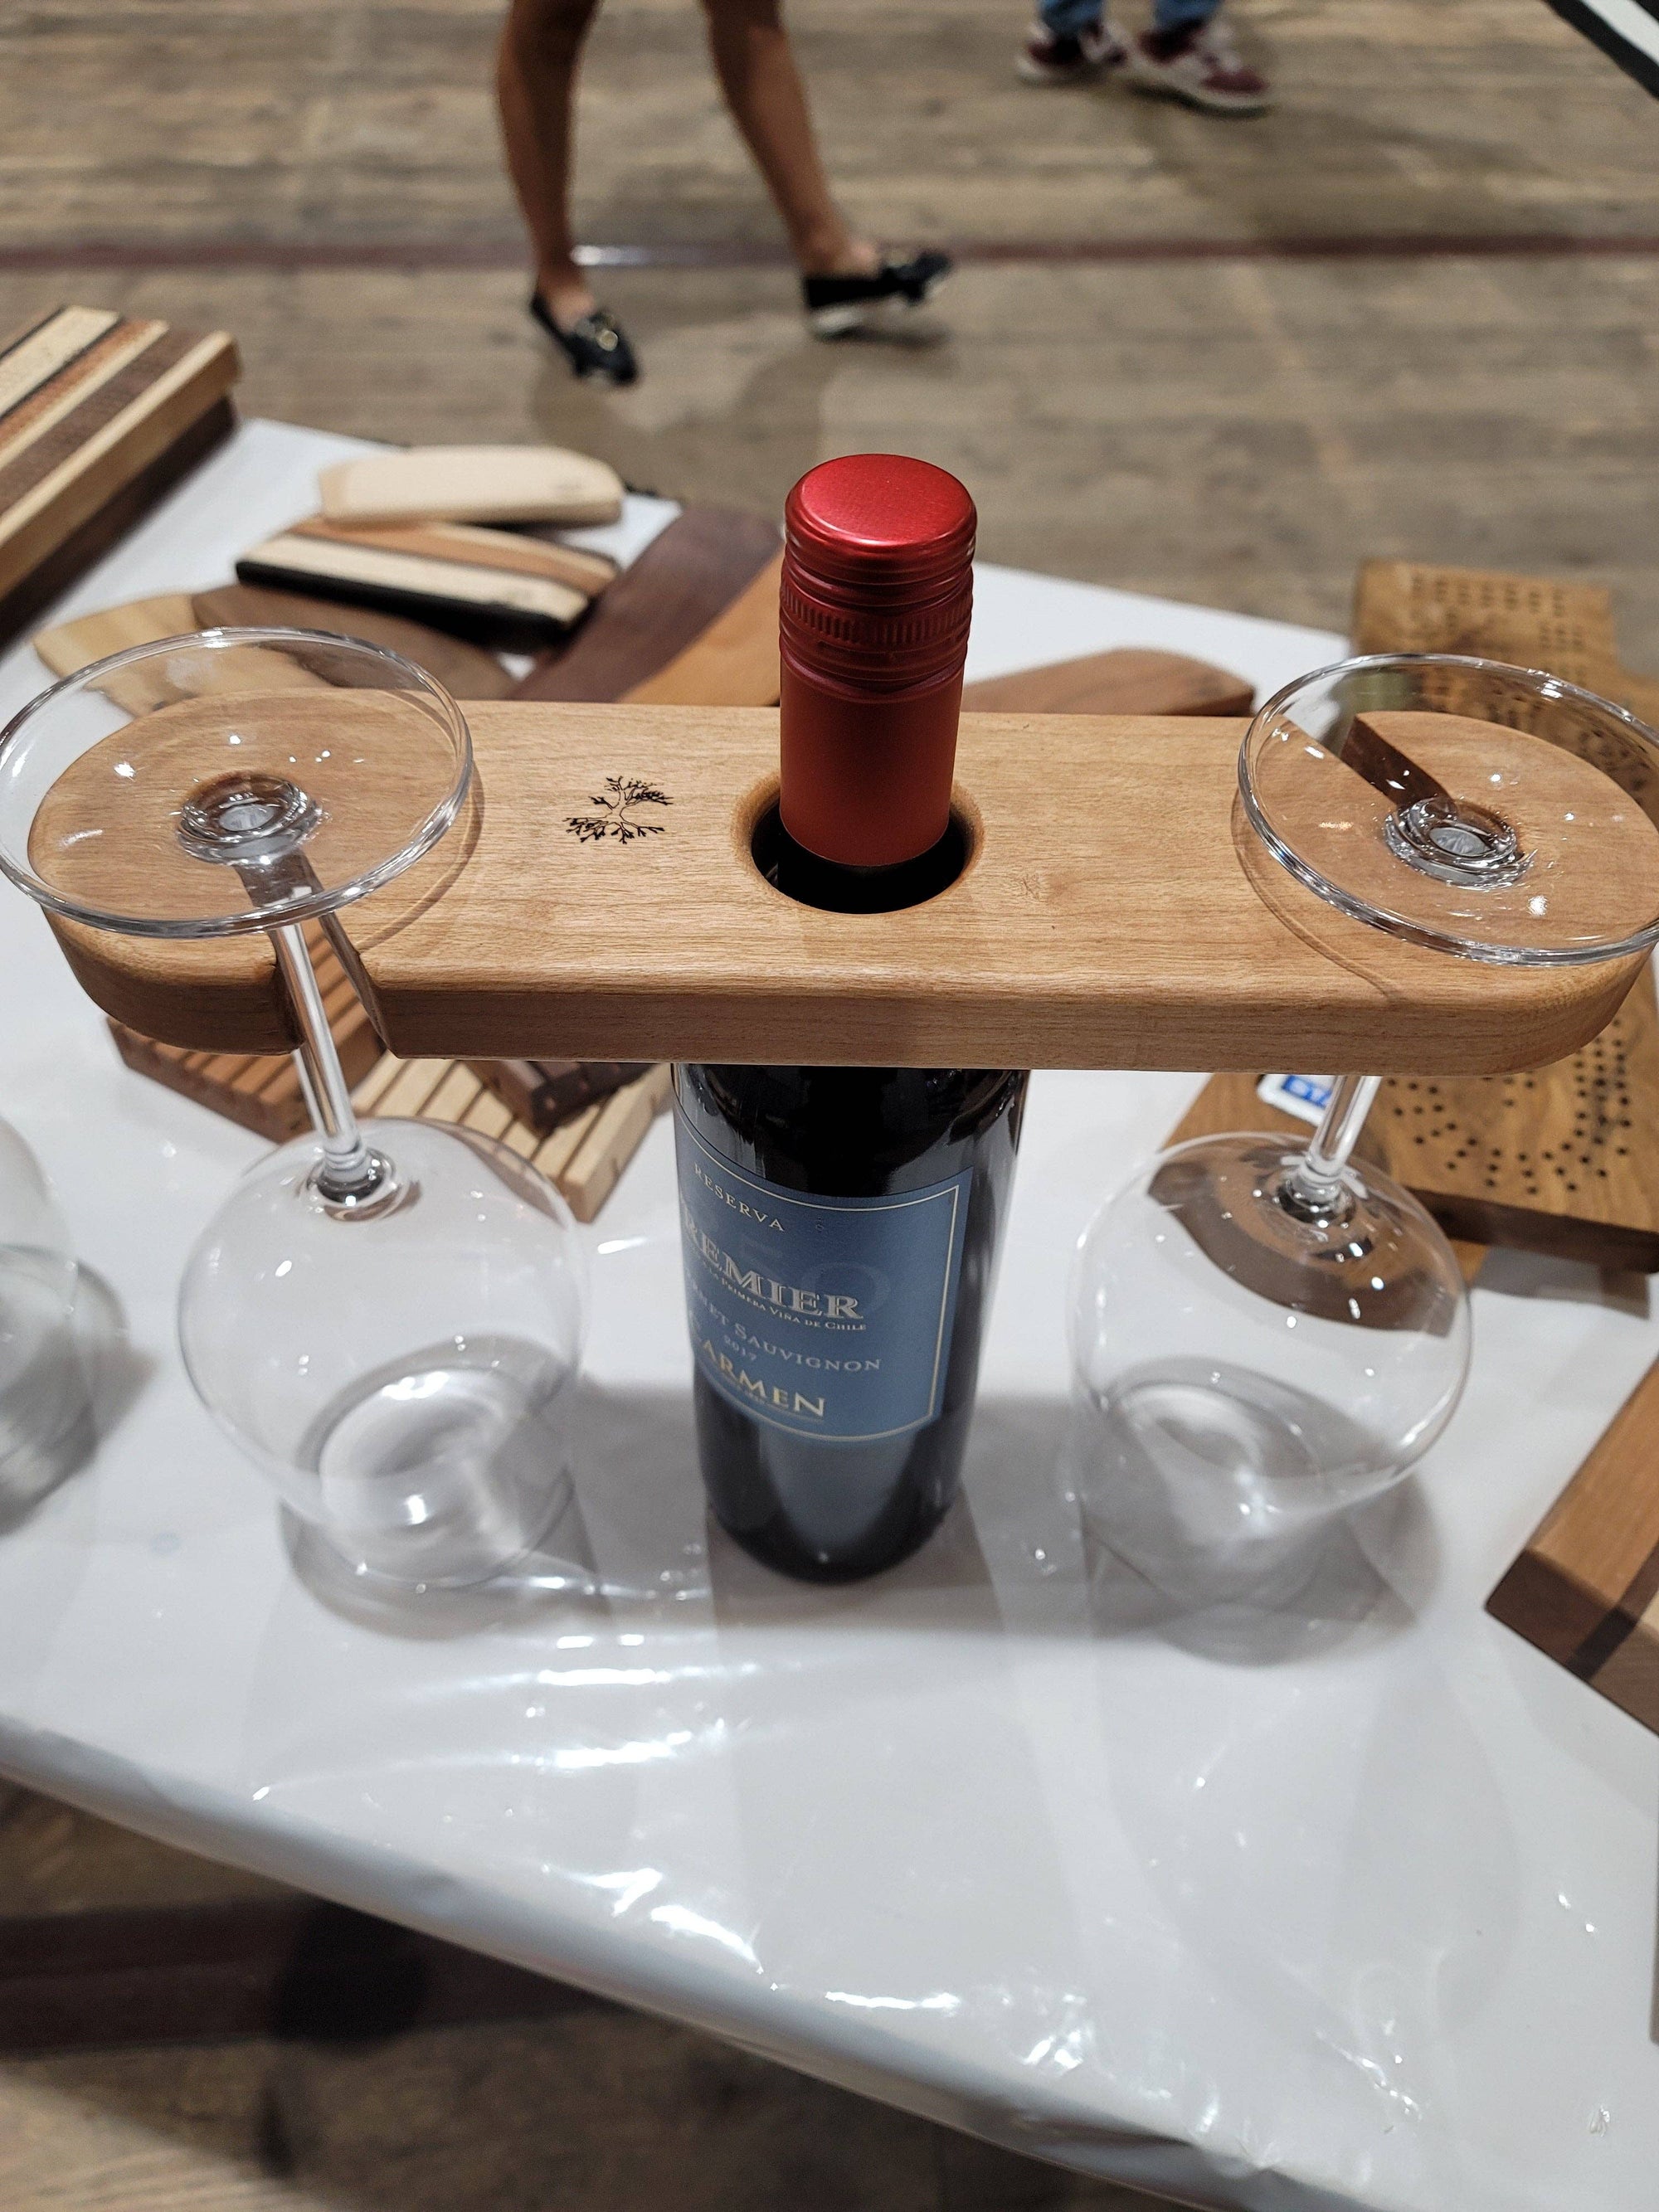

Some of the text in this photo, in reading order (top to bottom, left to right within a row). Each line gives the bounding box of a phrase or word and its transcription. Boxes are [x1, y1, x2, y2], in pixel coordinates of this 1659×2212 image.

[693, 1162, 786, 1232] RESERVA
[681, 1194, 864, 1320] REMIER
[700, 1338, 825, 1417] ARMEN
[734, 1322, 882, 1372] SAUVIGNON
